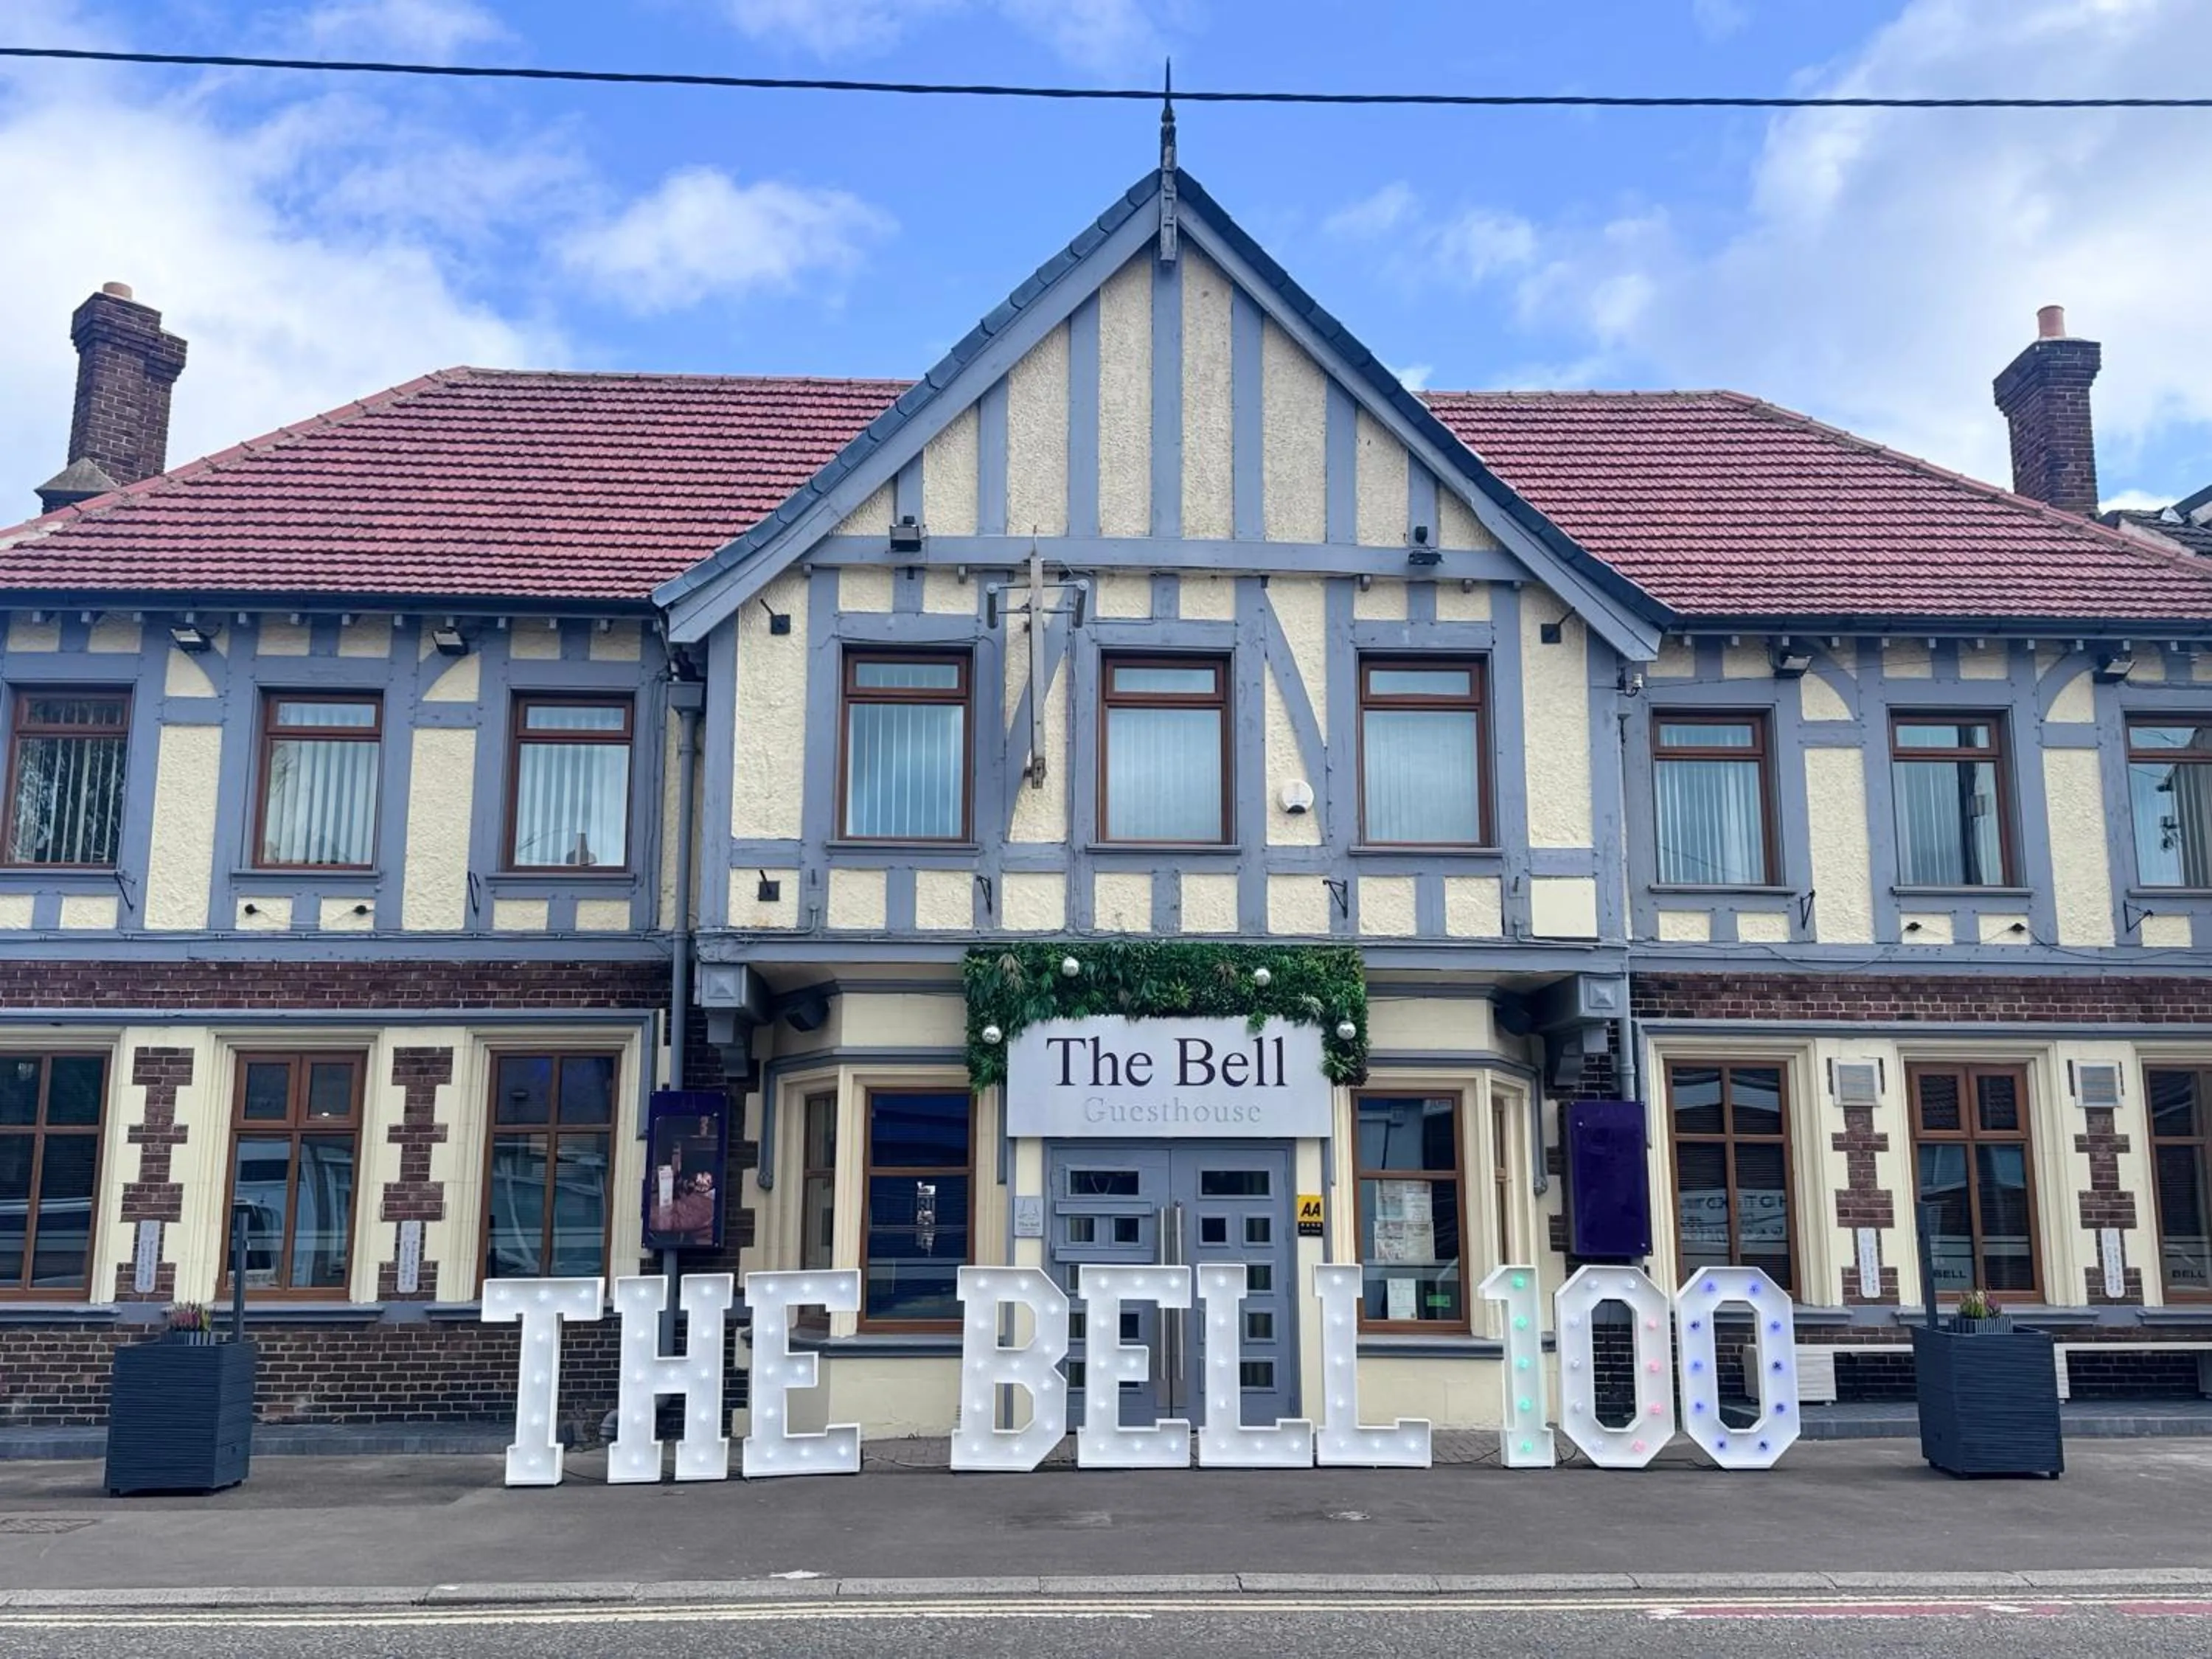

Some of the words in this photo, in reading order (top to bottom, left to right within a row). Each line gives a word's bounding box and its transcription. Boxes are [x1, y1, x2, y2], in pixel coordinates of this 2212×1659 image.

[1046, 1035, 1154, 1088] The
[1173, 1035, 1288, 1088] Bell
[1084, 1096, 1262, 1124] Guesthouse
[1301, 1201, 1321, 1217] AA
[1933, 1269, 1967, 1279] BELL
[481, 1269, 861, 1486] THE
[950, 1263, 1433, 1472] BELL
[1478, 1264, 1801, 1470] 100
